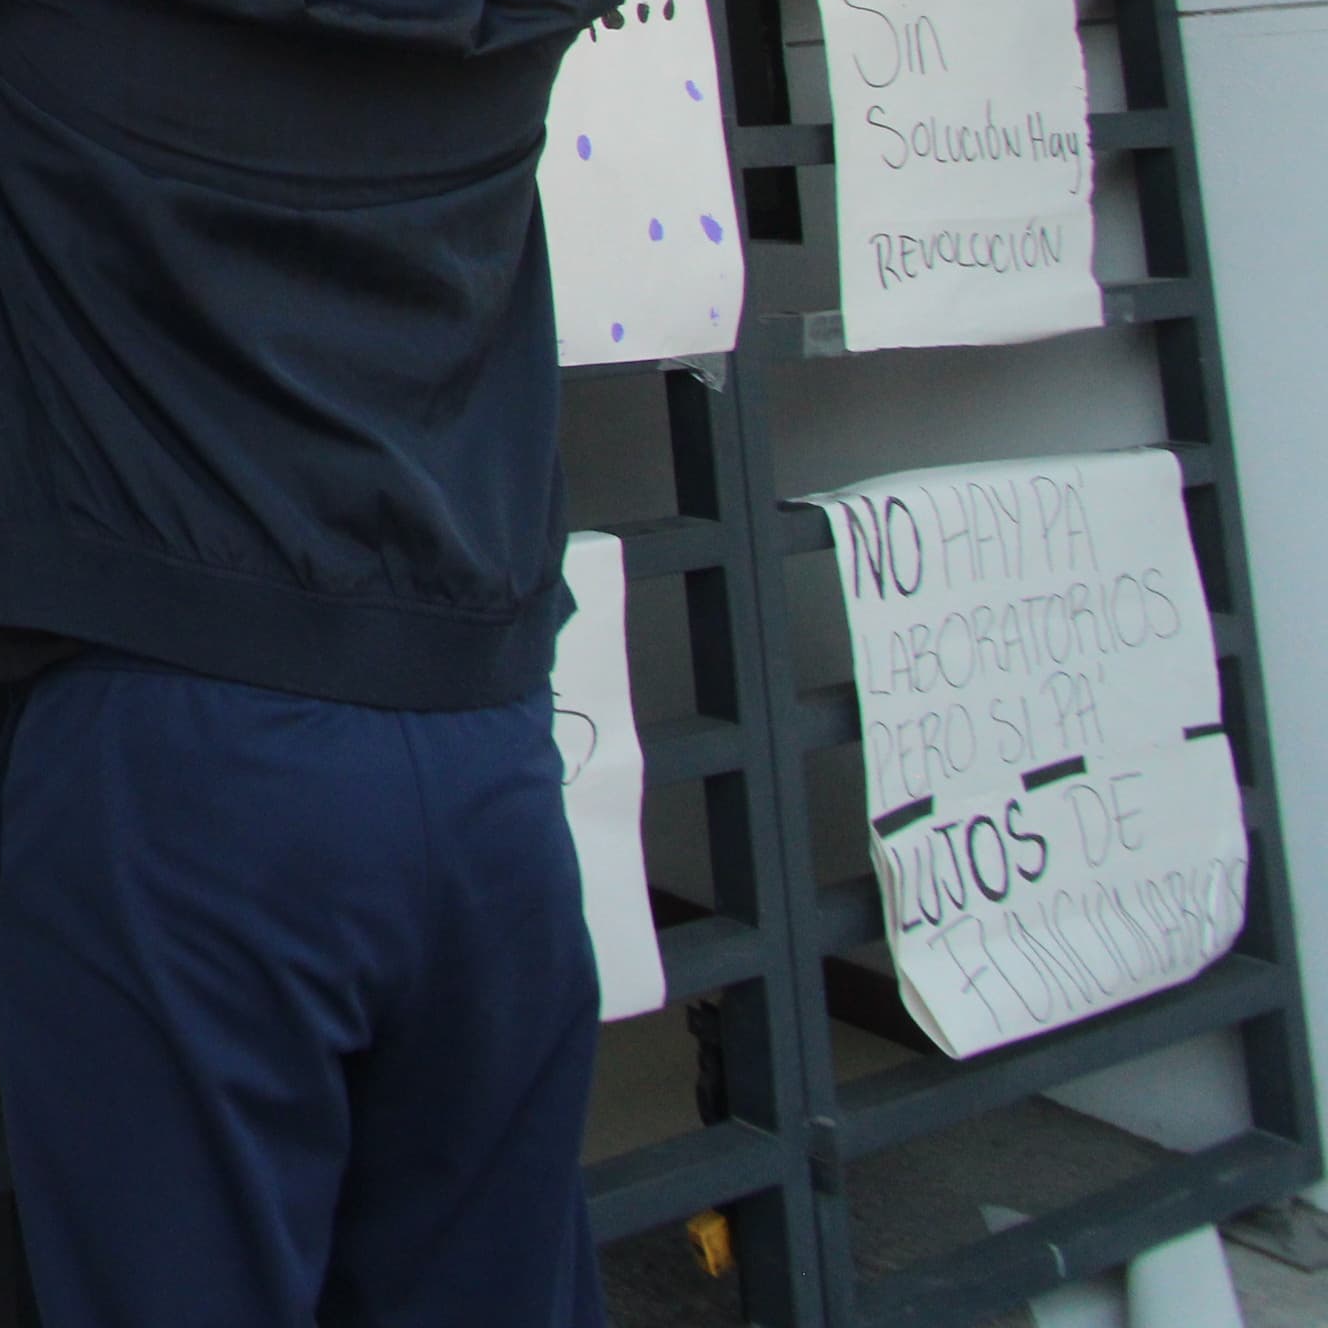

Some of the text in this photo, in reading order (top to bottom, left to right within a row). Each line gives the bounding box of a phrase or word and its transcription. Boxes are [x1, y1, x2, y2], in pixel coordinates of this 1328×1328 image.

[1026, 110, 1083, 196] Hay
[868, 215, 1063, 291] REVOLUCIÓN
[838, 494, 923, 602] NO
[920, 485, 1023, 590] HAY
[859, 567, 1183, 698] LABORATORIOS
[866, 702, 978, 812] PERO
[891, 771, 1144, 933] LUJOS DE
